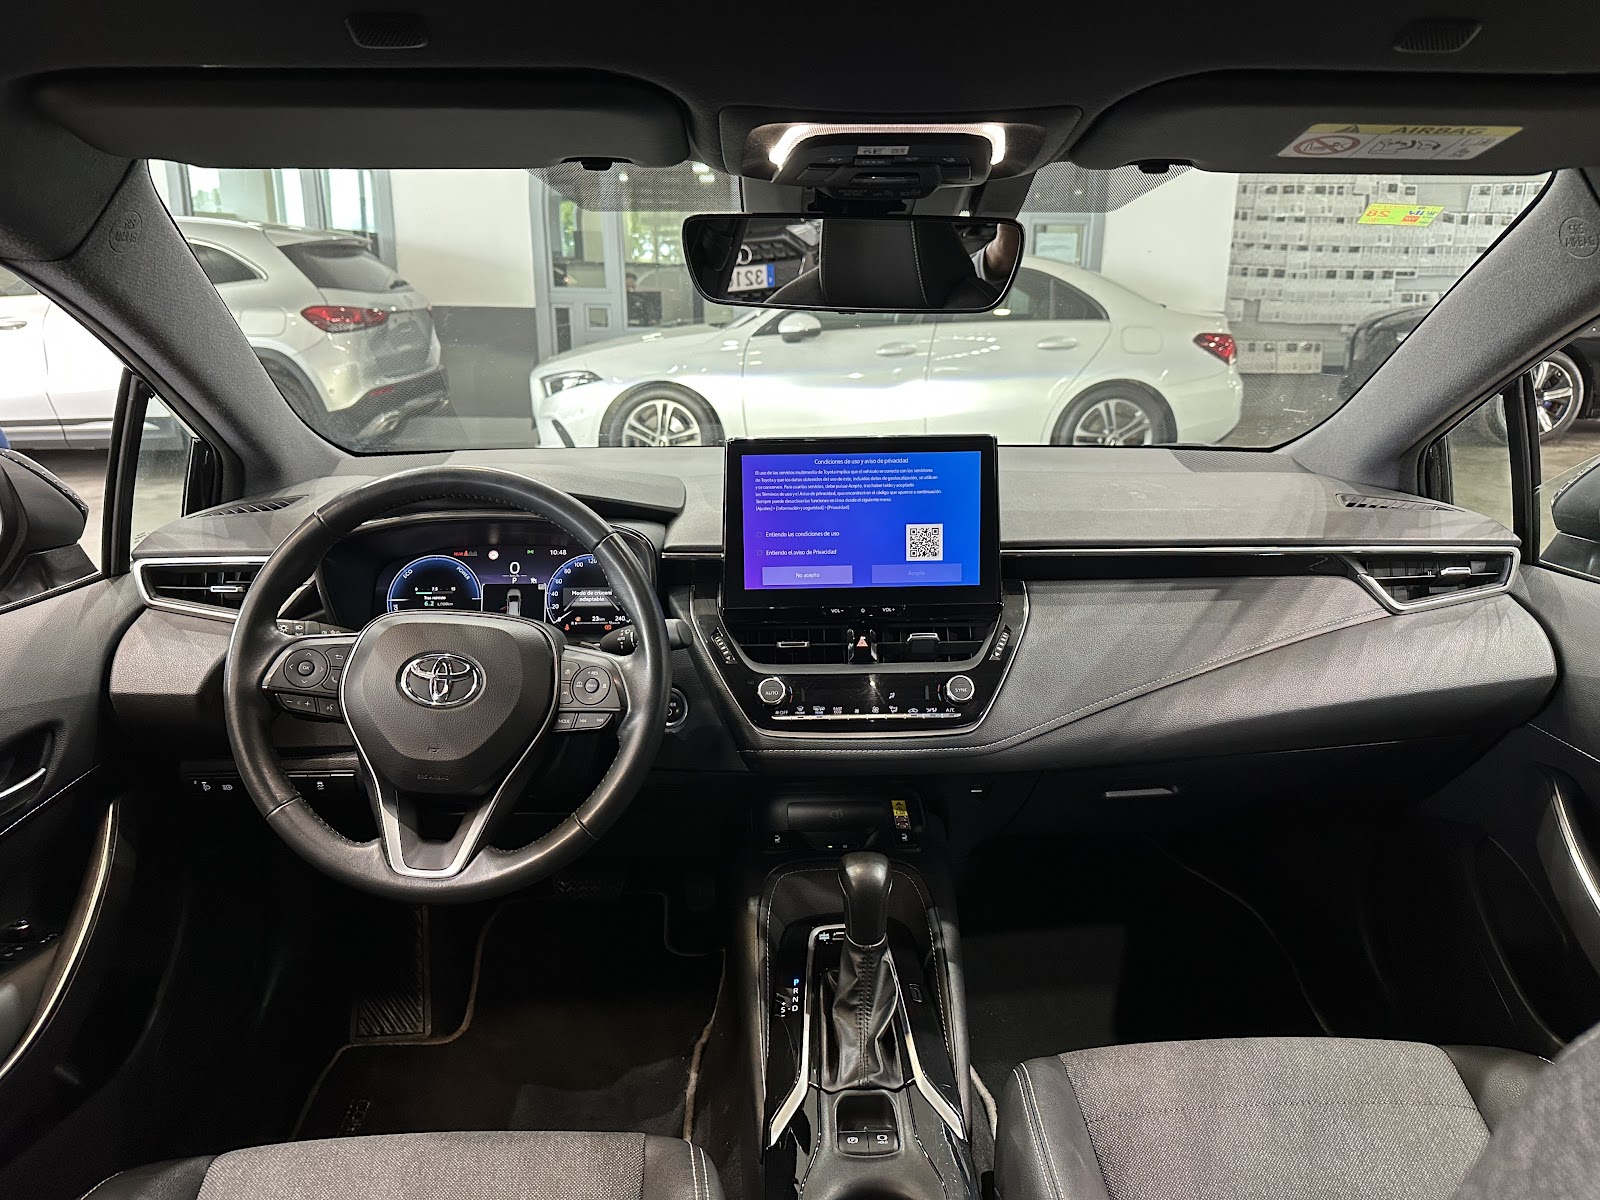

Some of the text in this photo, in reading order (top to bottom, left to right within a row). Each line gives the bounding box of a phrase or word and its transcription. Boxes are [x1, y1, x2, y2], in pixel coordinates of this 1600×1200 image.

[1390, 126, 1487, 134] AIRBAG
[456, 566, 471, 580] POWER
[510, 562, 520, 574] 0
